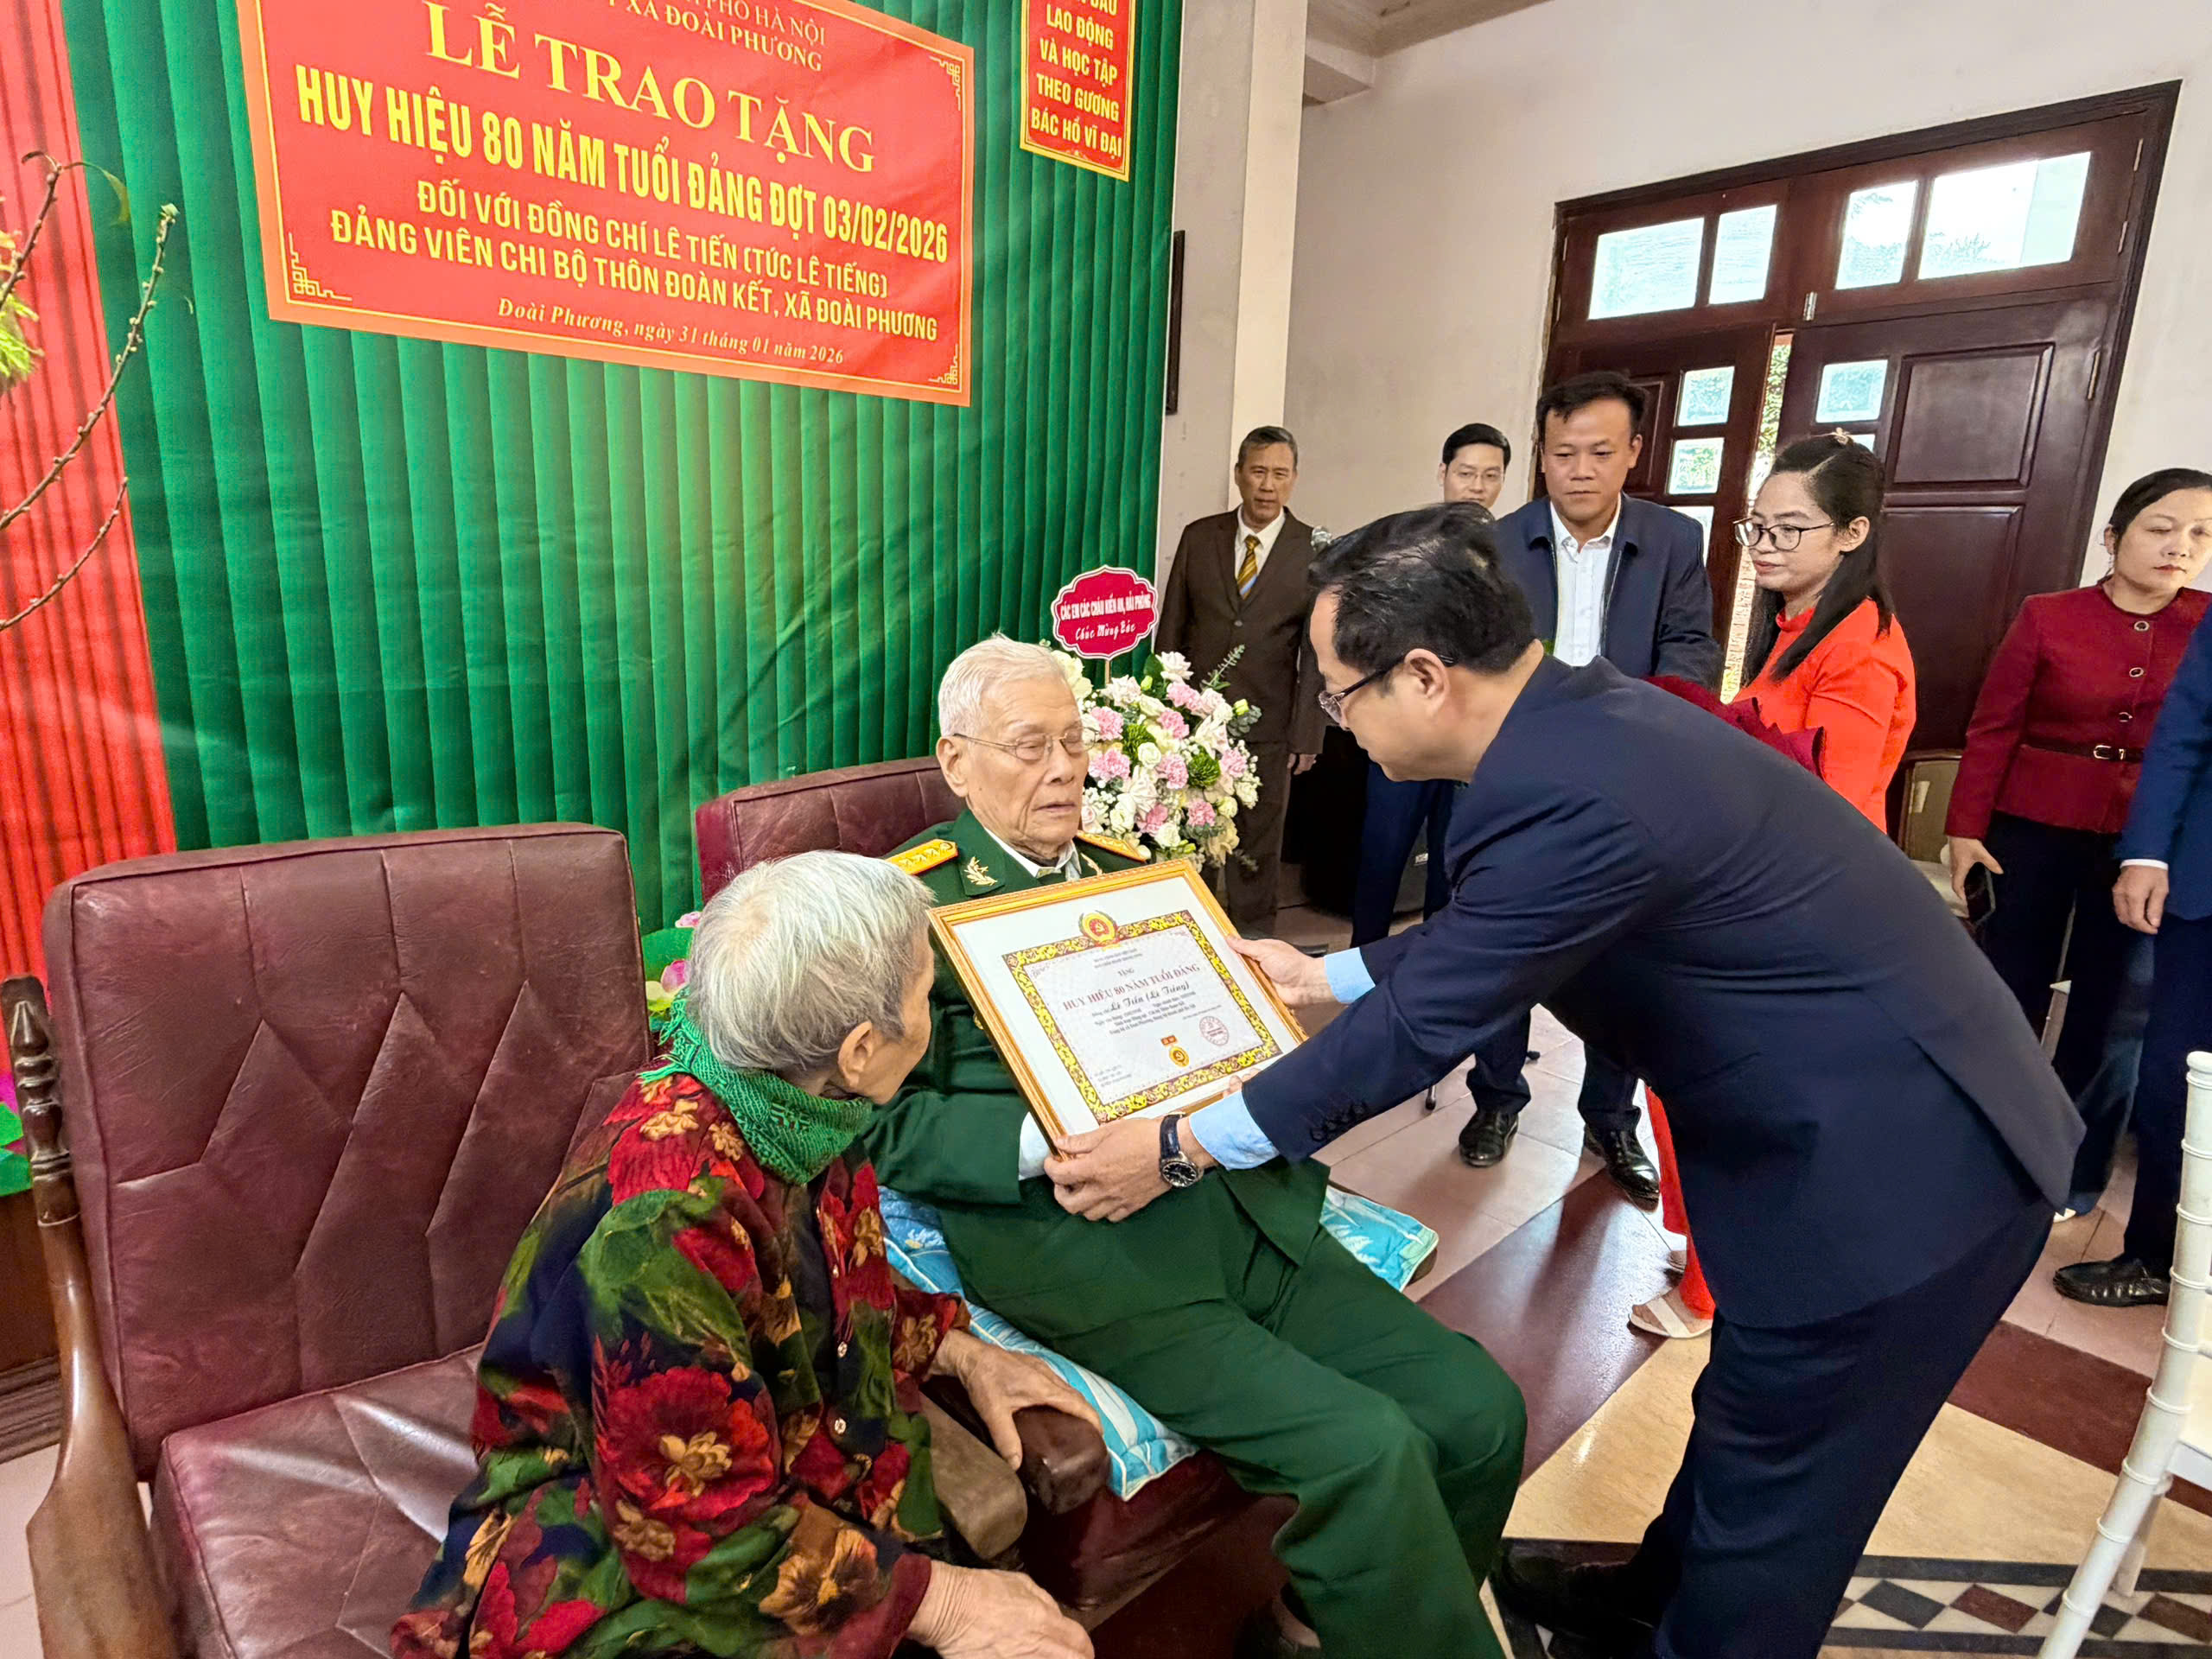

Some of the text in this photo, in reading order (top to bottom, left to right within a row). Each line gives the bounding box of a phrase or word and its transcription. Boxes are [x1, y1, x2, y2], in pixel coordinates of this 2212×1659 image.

[664, 3, 724, 41] ĐOÀI
[730, 24, 822, 72] PHƯƠNG
[755, 5, 785, 33] HÀ
[790, 16, 825, 46] NỘI
[1046, 3, 1072, 35] LAO
[1076, 16, 1114, 51] ĐỘNG
[423, 0, 875, 173] LỄ TRAO TẶNG
[1039, 37, 1118, 88] VÀ HỌC TẬP
[1036, 73, 1121, 123] THEO GƯƠNG
[1031, 106, 1059, 137] BÁC
[1084, 124, 1097, 149] VĨ
[1100, 131, 1122, 160] ĐẠI
[296, 64, 949, 264] HUY HIỆU 80 NĂM TUỔI ĐẢNG ĐỢT 03/02/2026
[417, 178, 467, 220] ĐỐI
[473, 191, 521, 231] VỚI
[527, 200, 600, 245] ĐỒNG
[606, 219, 648, 254] CHÍ
[653, 226, 682, 260] LÊ
[685, 233, 738, 270] TIẾN
[797, 255, 821, 286] LÊ
[823, 261, 889, 299] TIẾNG)
[330, 204, 938, 342] ĐẢNG VIÊN CHI BỘ THÔN ĐOÀN KẾT, XÃ ĐOÀI PHƯƠNG
[498, 297, 844, 365] Đoài Phương, ngày 31 tháng 01 năm 2026
[1063, 996, 1085, 1011] HUY
[1113, 985, 1125, 995] 80
